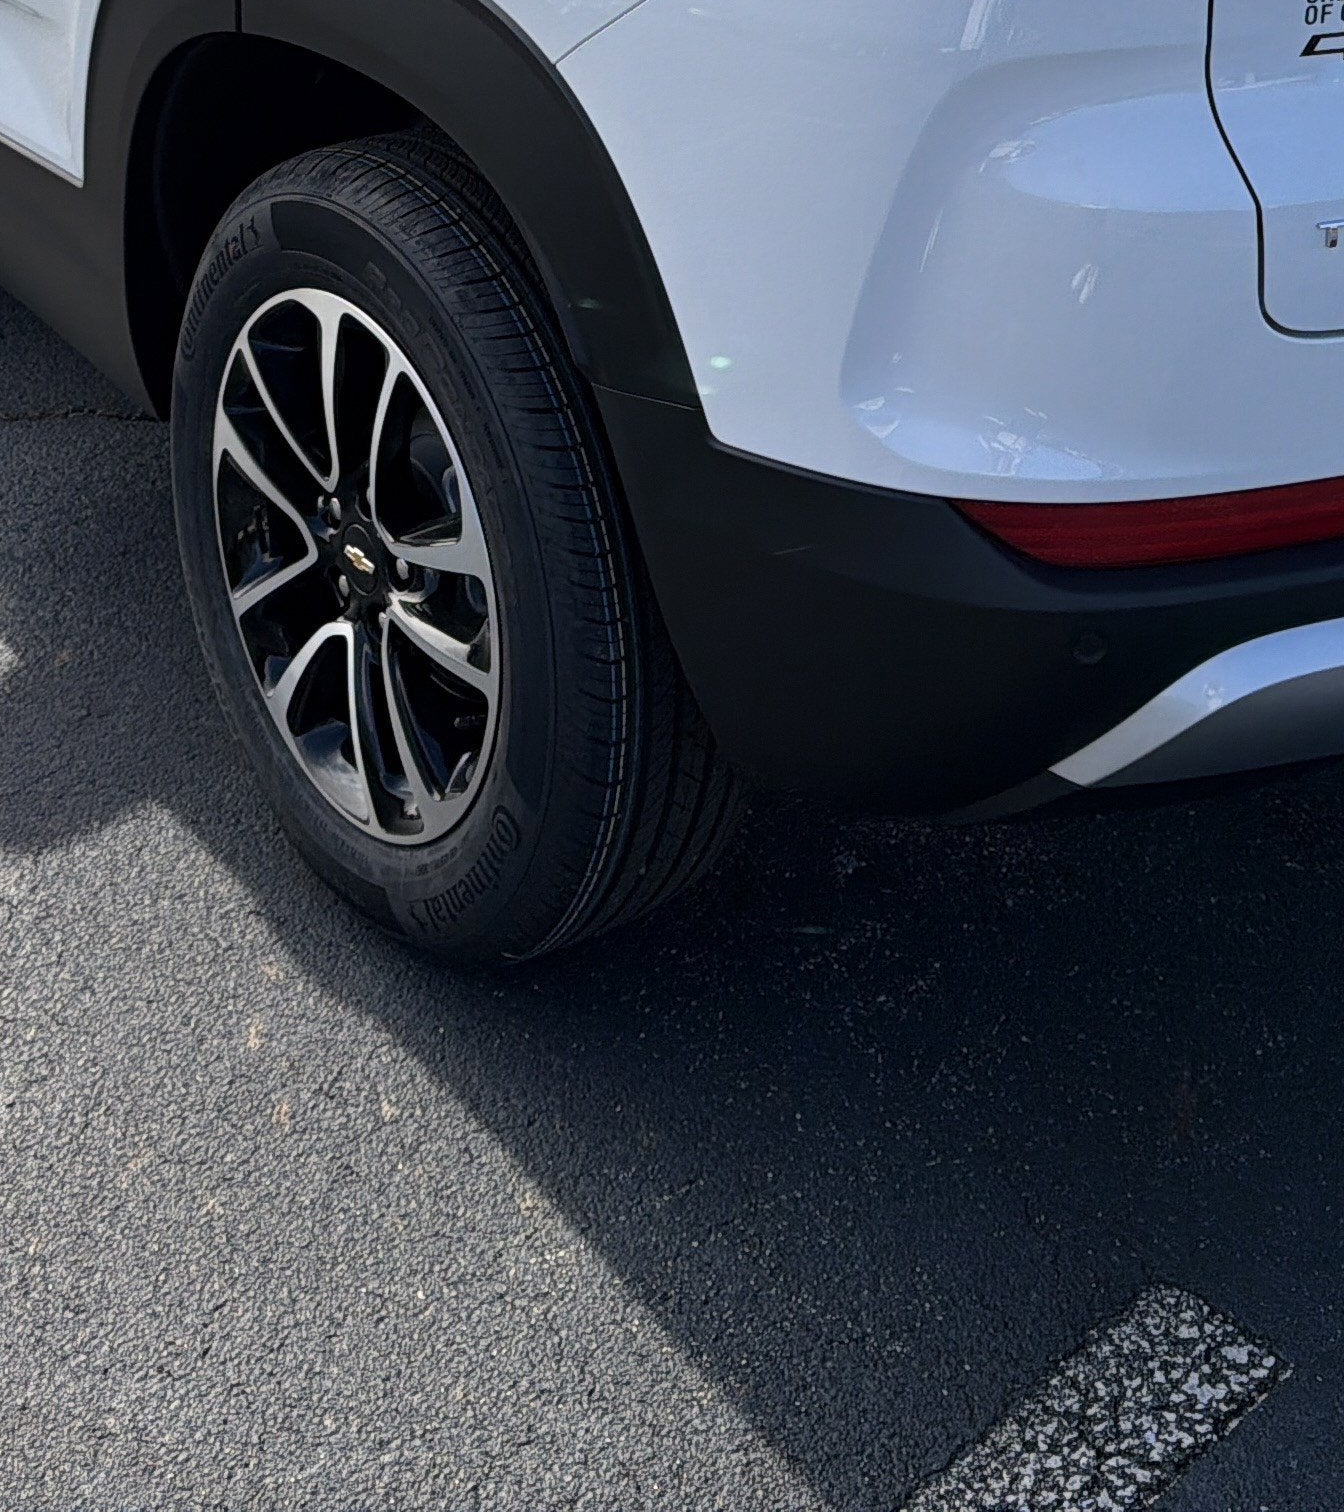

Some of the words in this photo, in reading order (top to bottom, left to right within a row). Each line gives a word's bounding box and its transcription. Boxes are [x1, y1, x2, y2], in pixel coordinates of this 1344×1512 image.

[1304, 3, 1333, 25] OF
[180, 222, 250, 362] Continental
[422, 804, 523, 932] Continental
